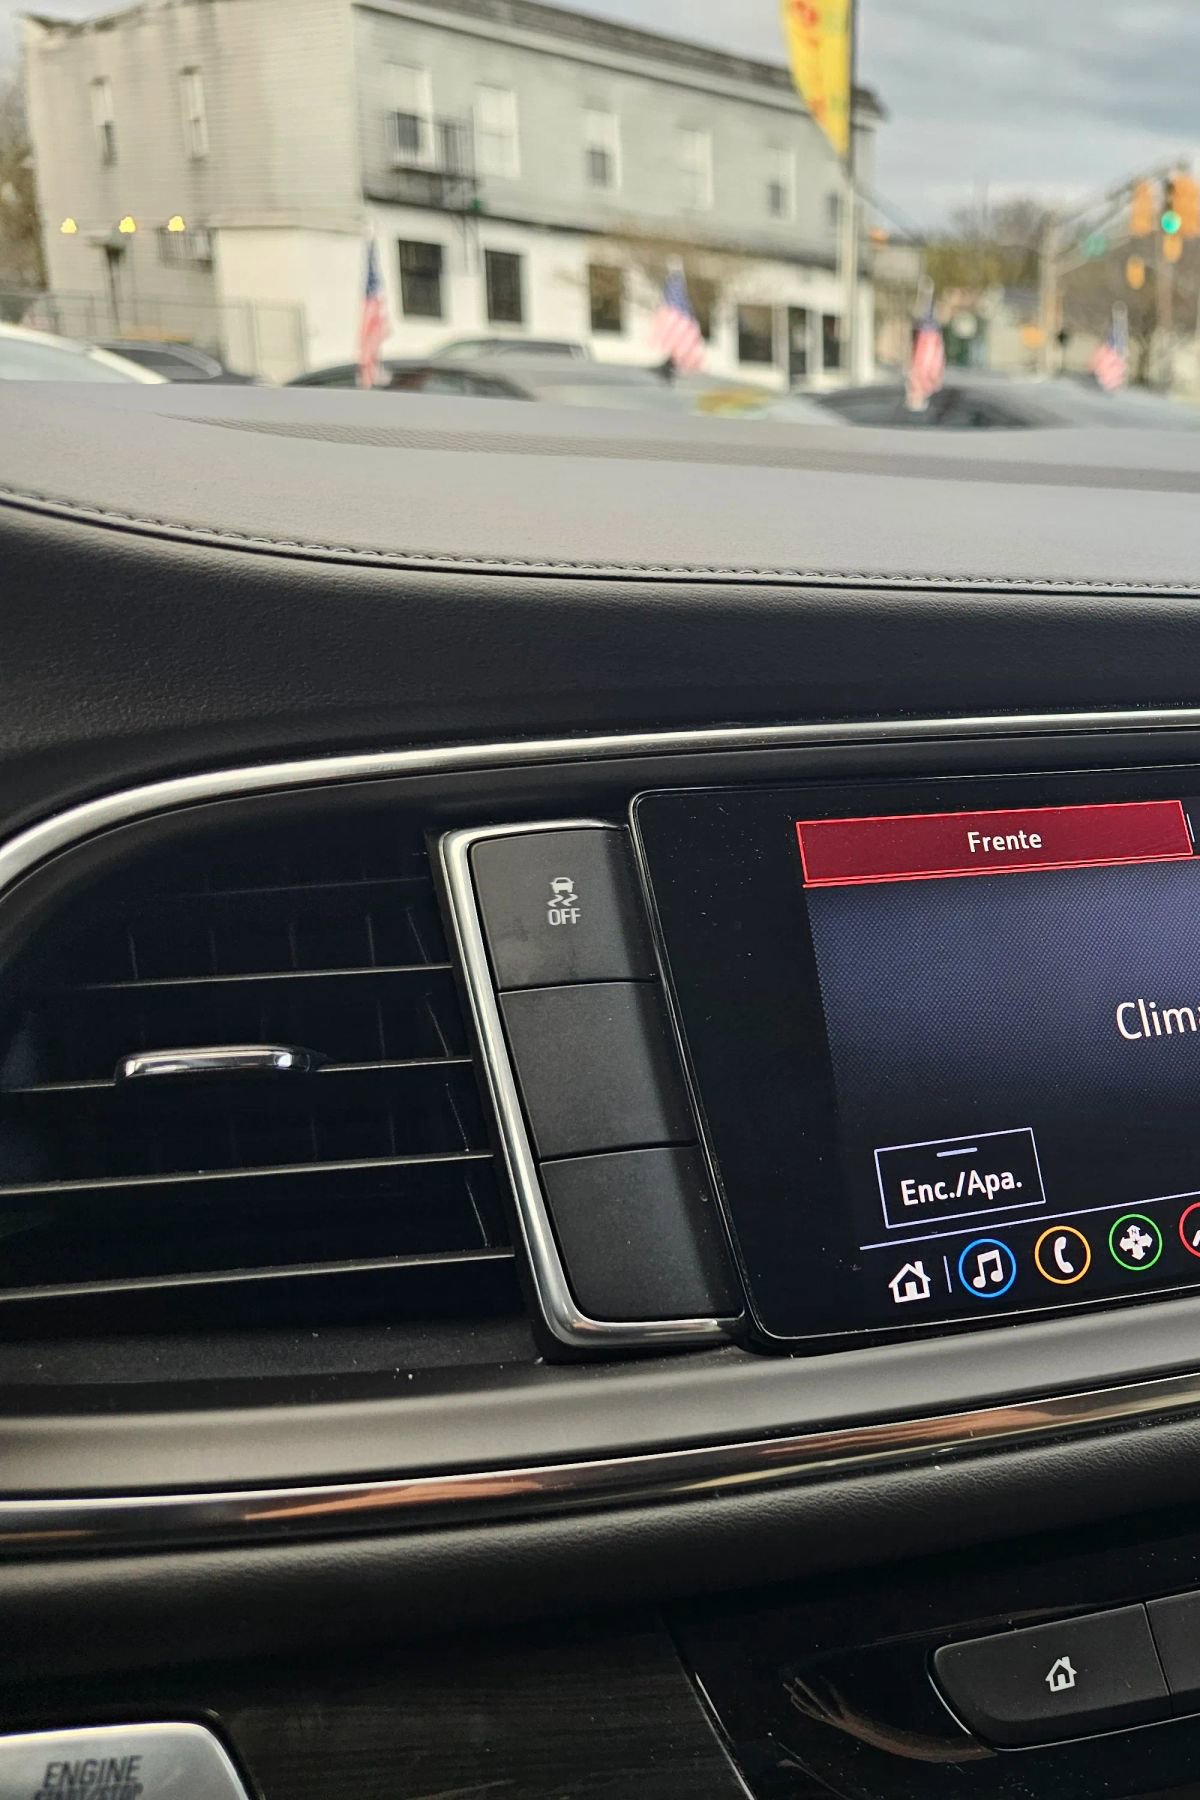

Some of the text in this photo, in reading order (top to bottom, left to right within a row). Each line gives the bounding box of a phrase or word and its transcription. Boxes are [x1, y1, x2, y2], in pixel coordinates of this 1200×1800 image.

[966, 830, 1043, 854] Frente
[548, 907, 582, 926] OFF
[900, 1169, 1023, 1207] Enc./Apa.
[43, 1755, 144, 1789] ENGINE
